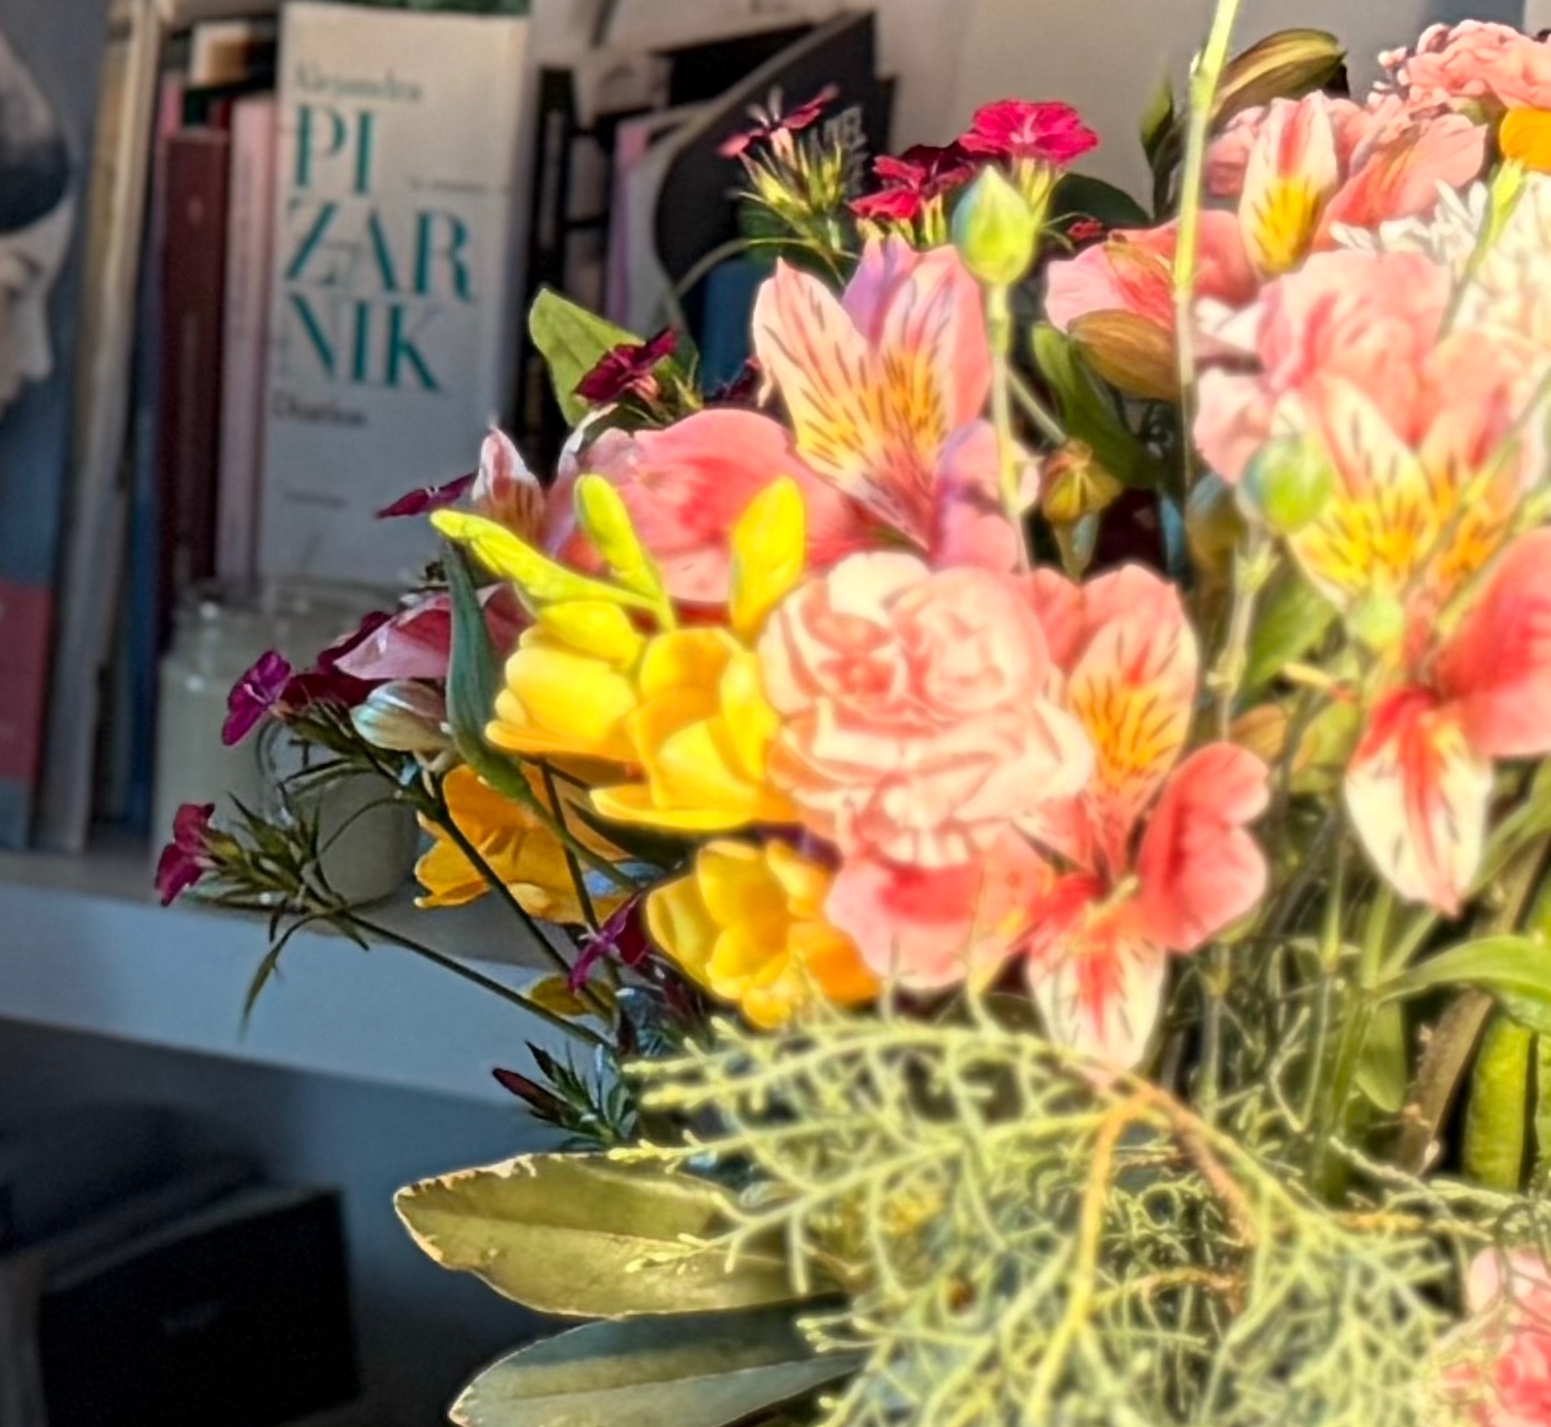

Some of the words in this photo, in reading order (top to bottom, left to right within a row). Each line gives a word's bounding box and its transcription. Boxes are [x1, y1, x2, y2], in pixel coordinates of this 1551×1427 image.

[293, 63, 422, 102] Alejandra
[293, 103, 374, 195] PI
[283, 198, 474, 304] ZAR
[285, 290, 442, 393] NIK
